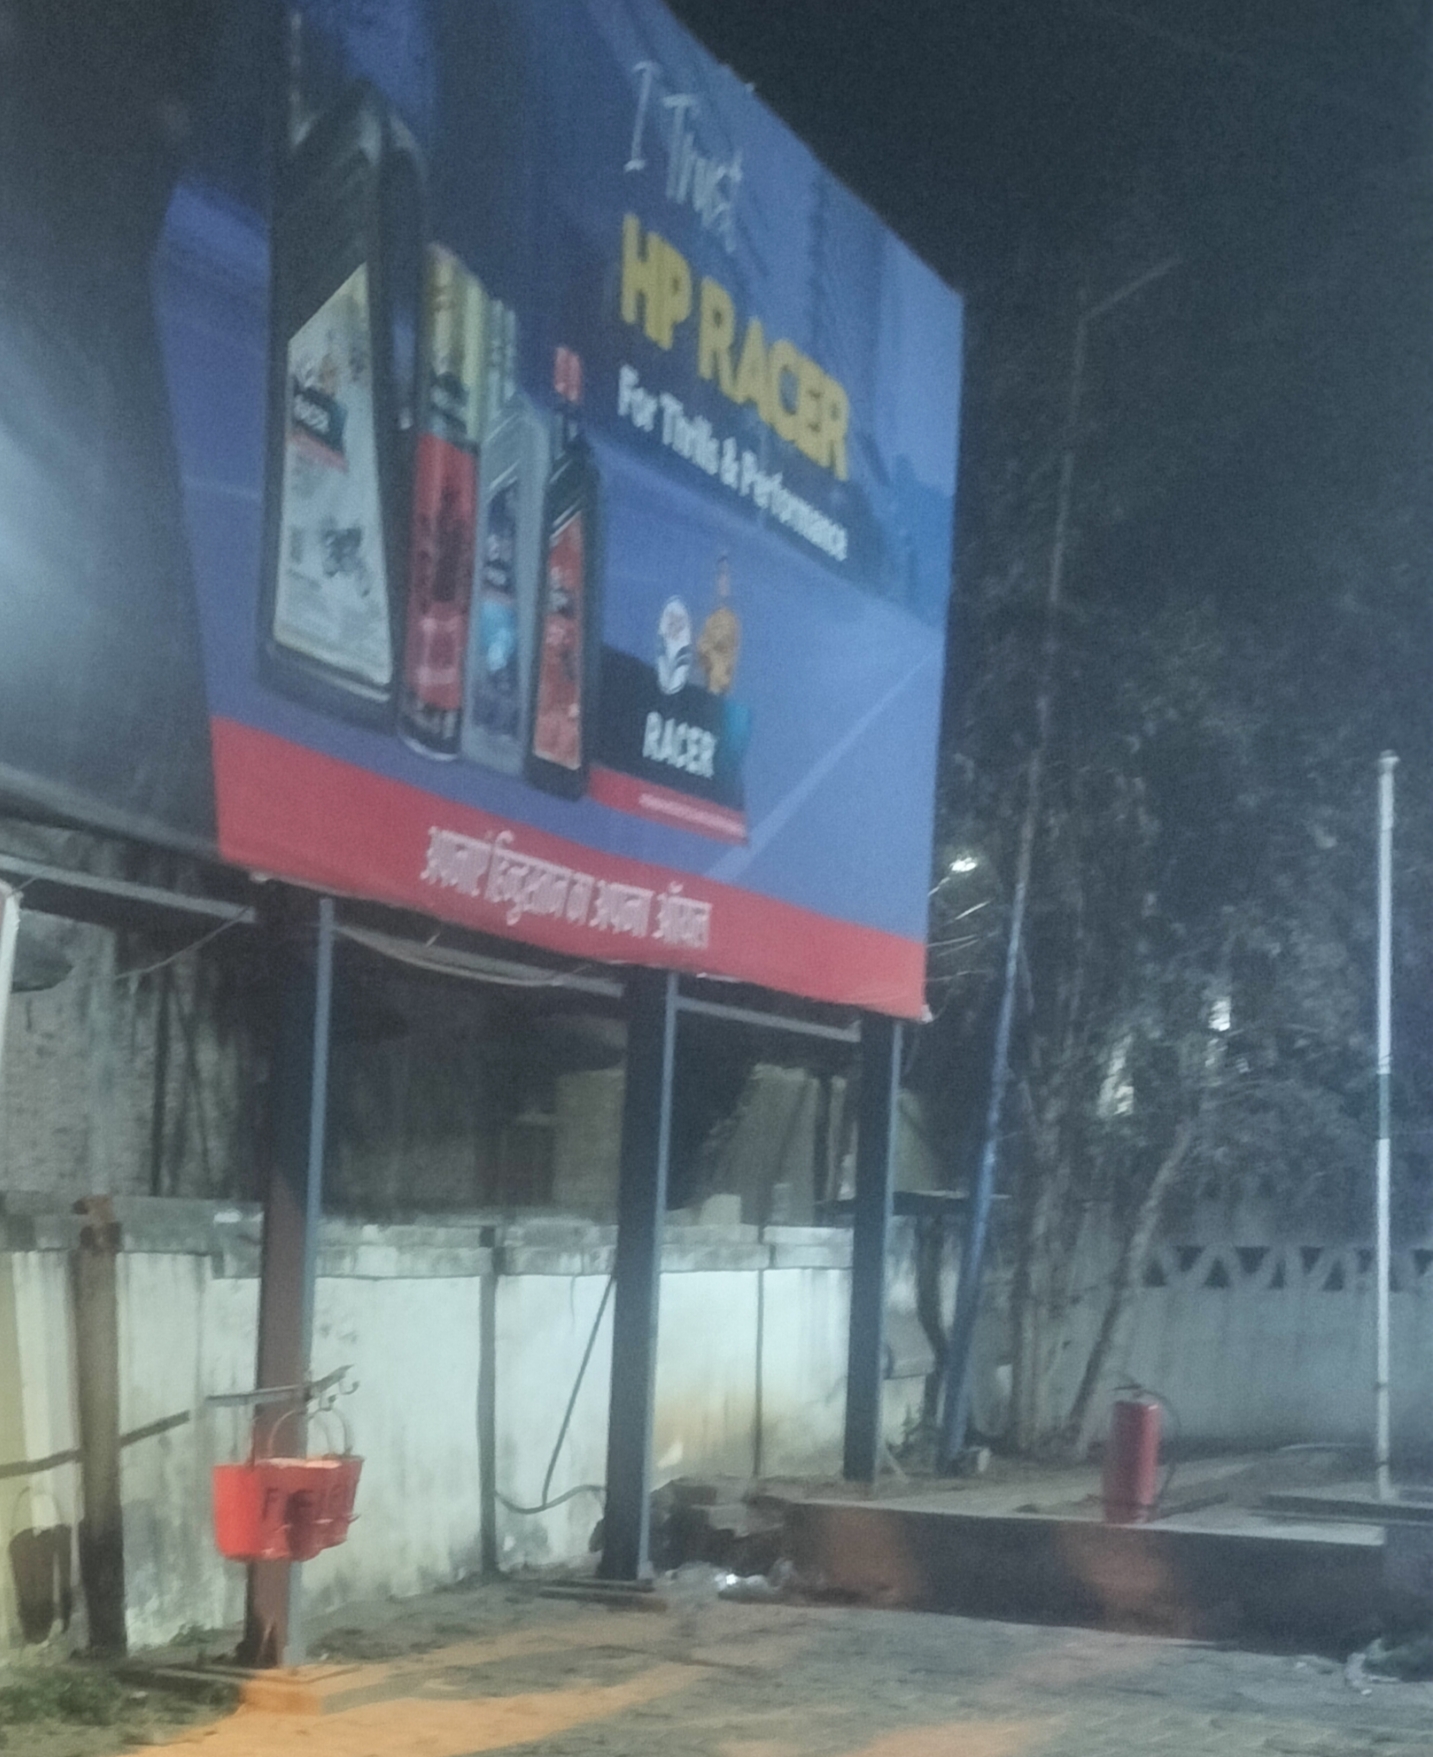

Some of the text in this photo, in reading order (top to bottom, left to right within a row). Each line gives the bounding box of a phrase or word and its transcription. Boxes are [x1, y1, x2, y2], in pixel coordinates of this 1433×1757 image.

[621, 212, 850, 482] HP RACER
[618, 363, 658, 433] For
[642, 711, 717, 779] RACER
